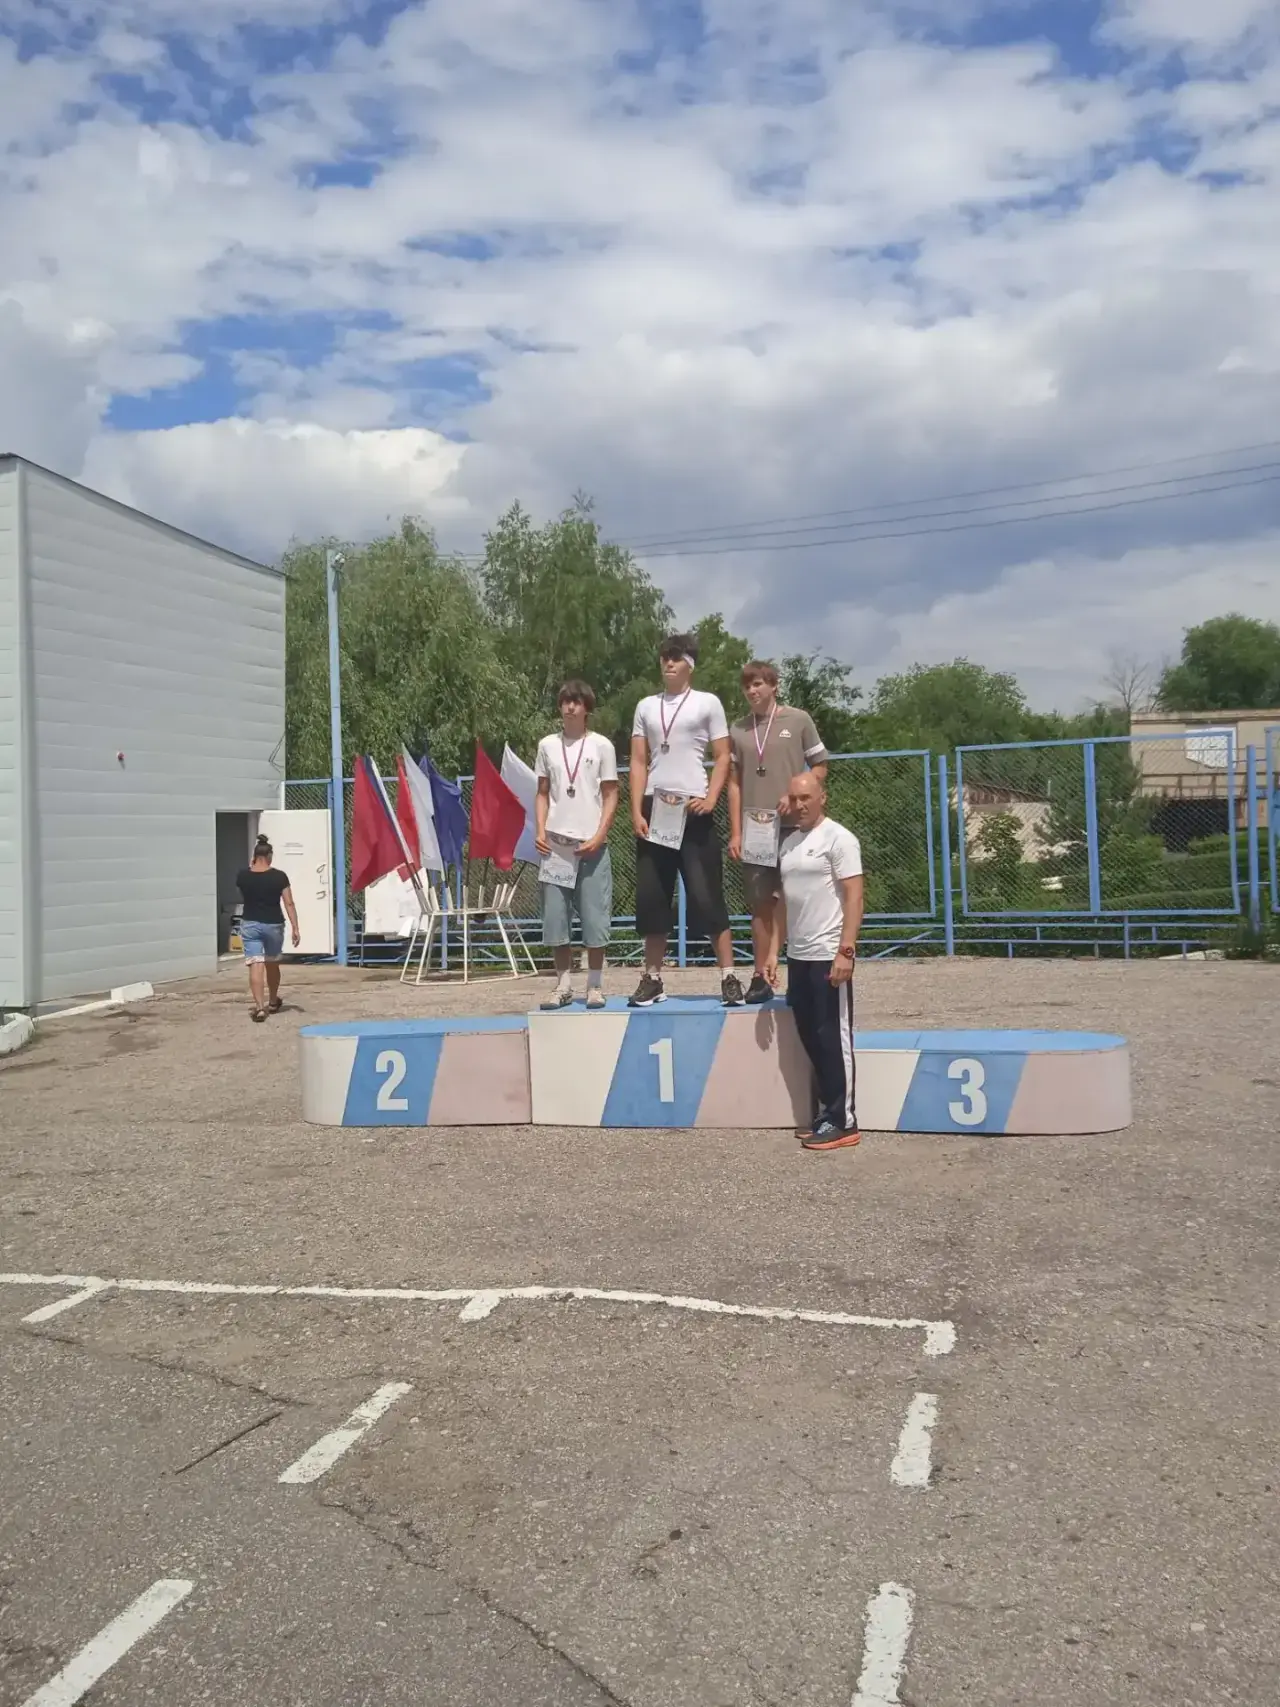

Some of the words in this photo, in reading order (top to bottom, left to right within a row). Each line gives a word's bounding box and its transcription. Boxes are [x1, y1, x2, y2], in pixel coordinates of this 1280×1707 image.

[375, 1051, 409, 1111] 2
[648, 1038, 675, 1103] 1
[948, 1058, 988, 1126] 3
